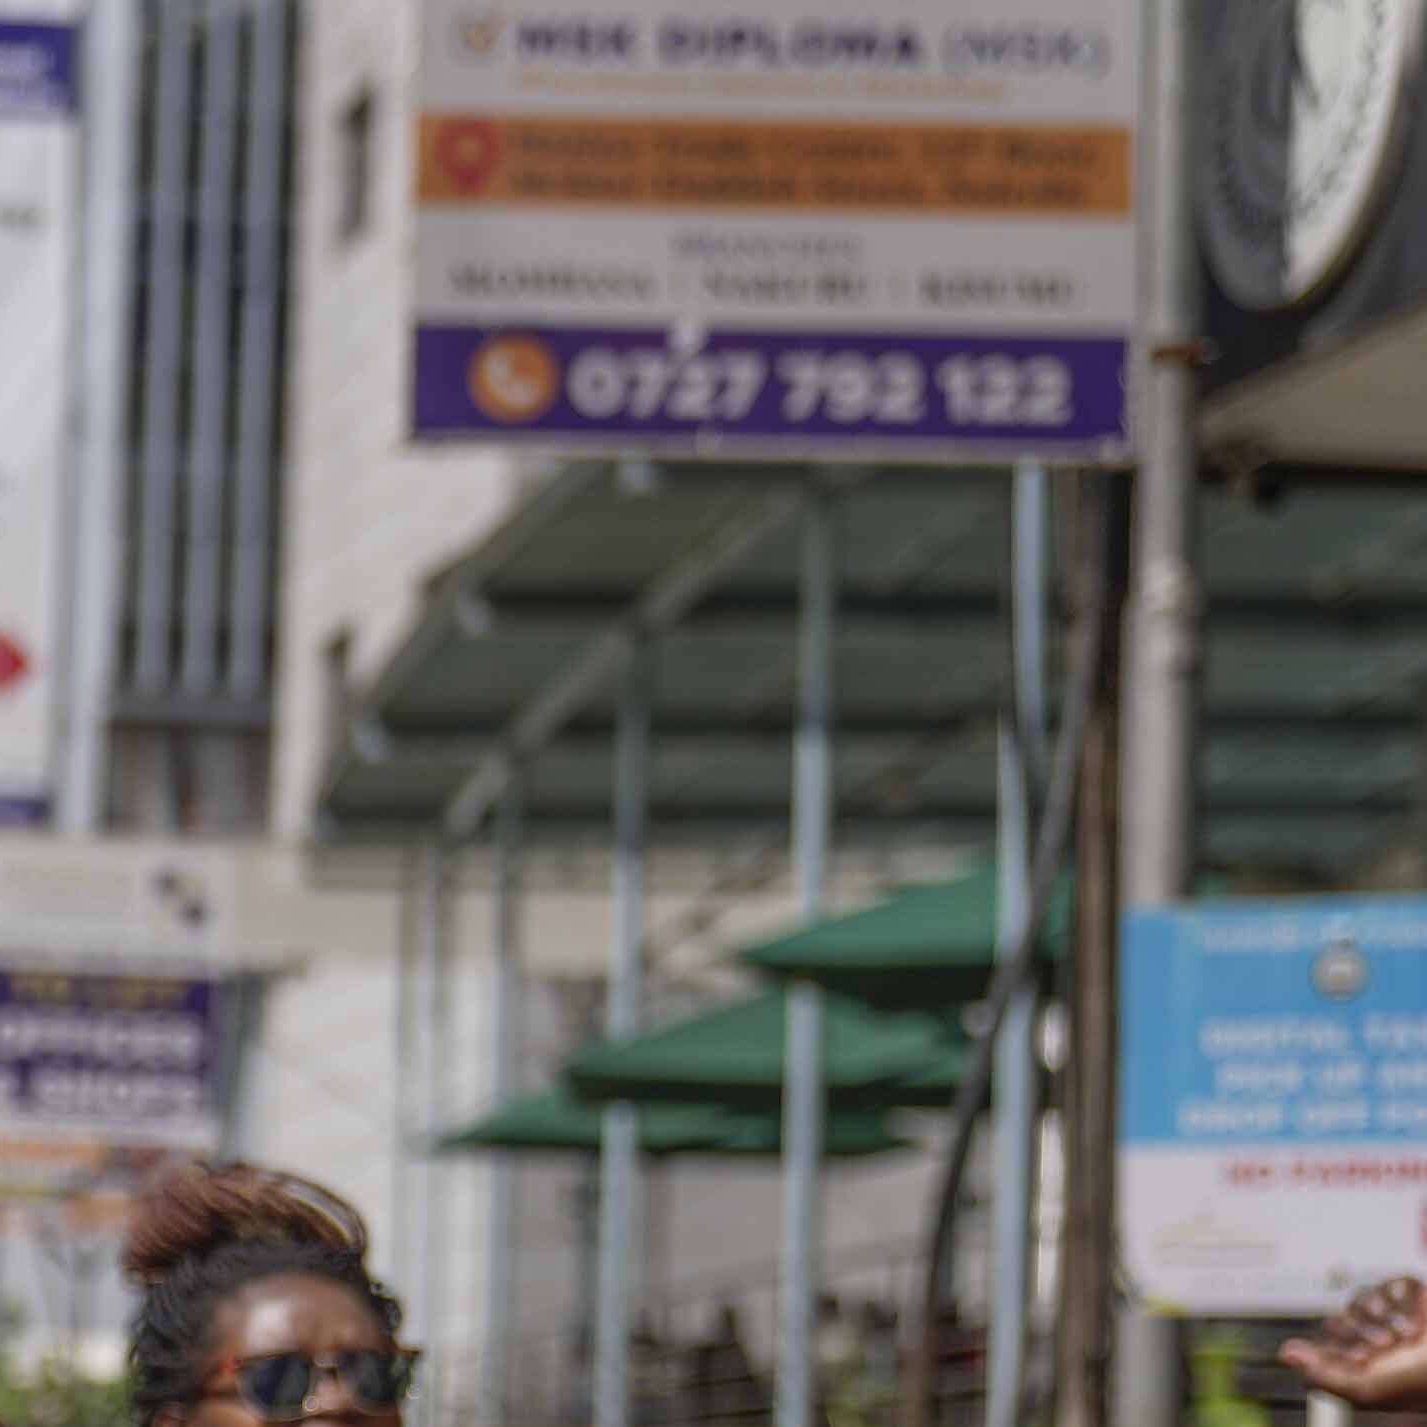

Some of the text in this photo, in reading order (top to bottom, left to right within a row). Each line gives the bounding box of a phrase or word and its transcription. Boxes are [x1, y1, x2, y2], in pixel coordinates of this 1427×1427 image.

[655, 24, 922, 67] DIPLOMA
[565, 347, 1075, 428] 0727 792 122
